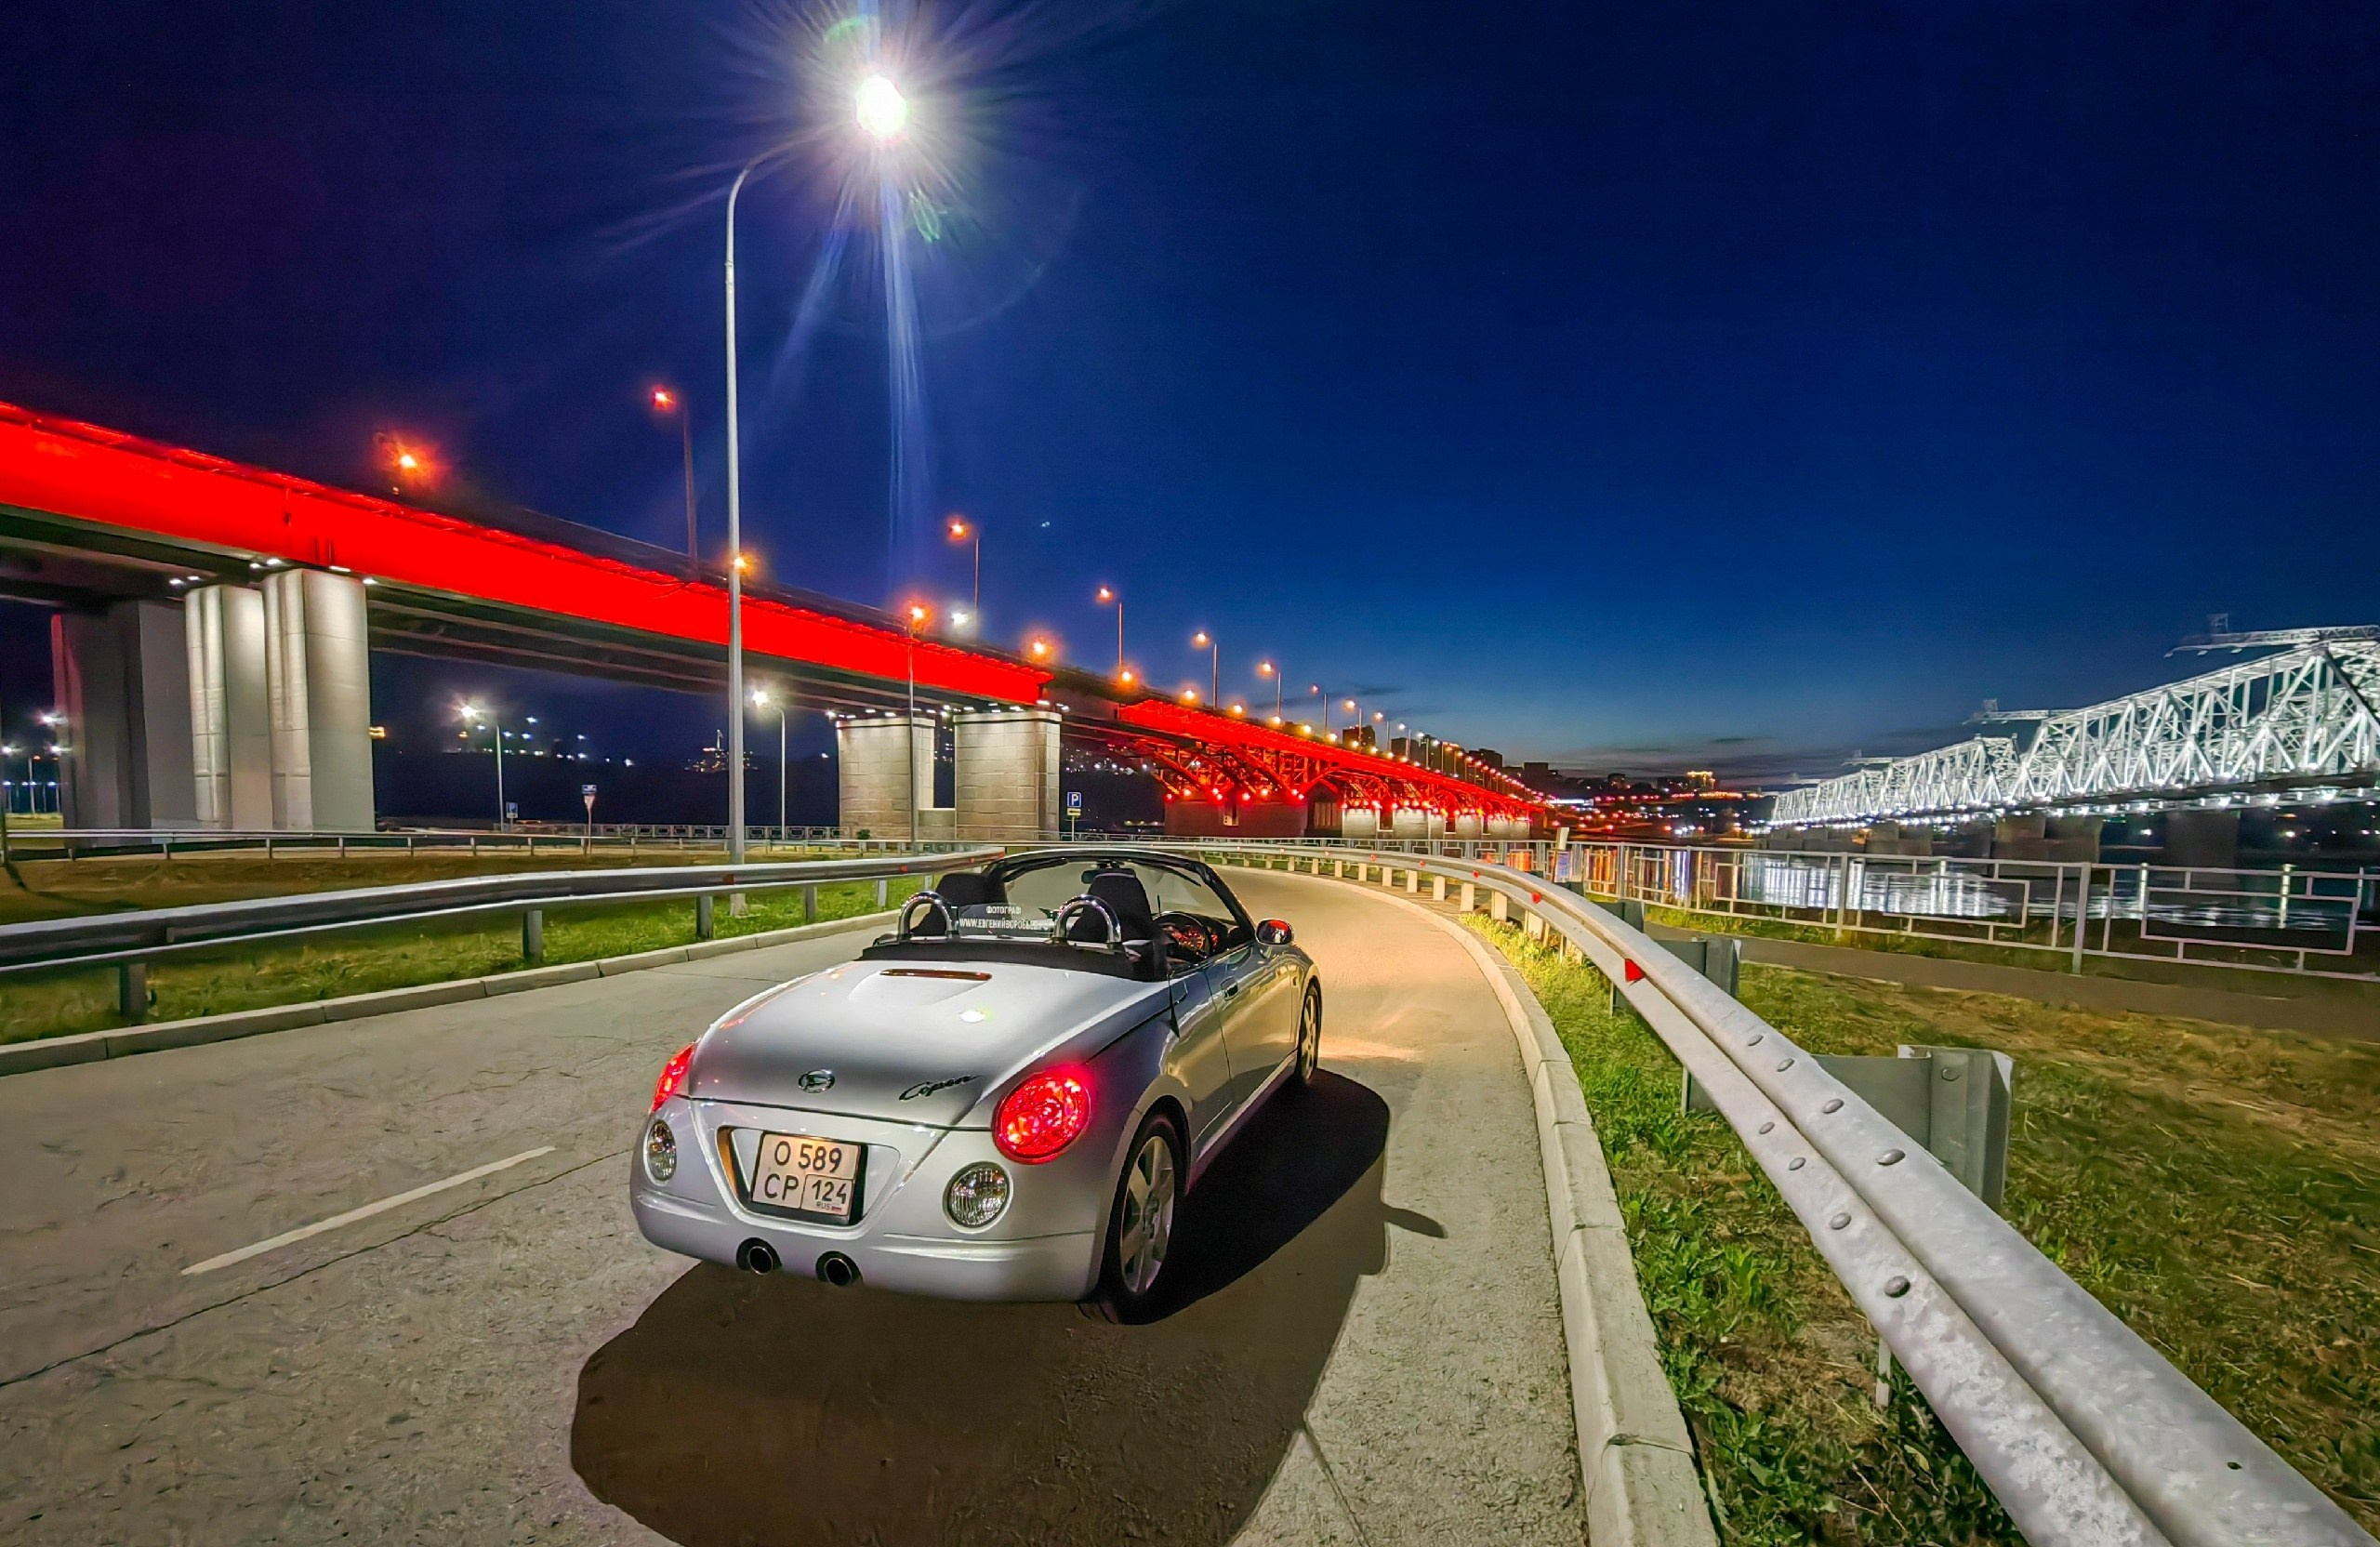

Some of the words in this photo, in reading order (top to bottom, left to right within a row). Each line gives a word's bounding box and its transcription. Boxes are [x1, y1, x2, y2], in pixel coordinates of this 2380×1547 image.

[1071, 793, 1079, 806] P
[798, 1144, 842, 1173] 589
[812, 1179, 847, 1205] 124
[815, 1200, 832, 1210] RUS
